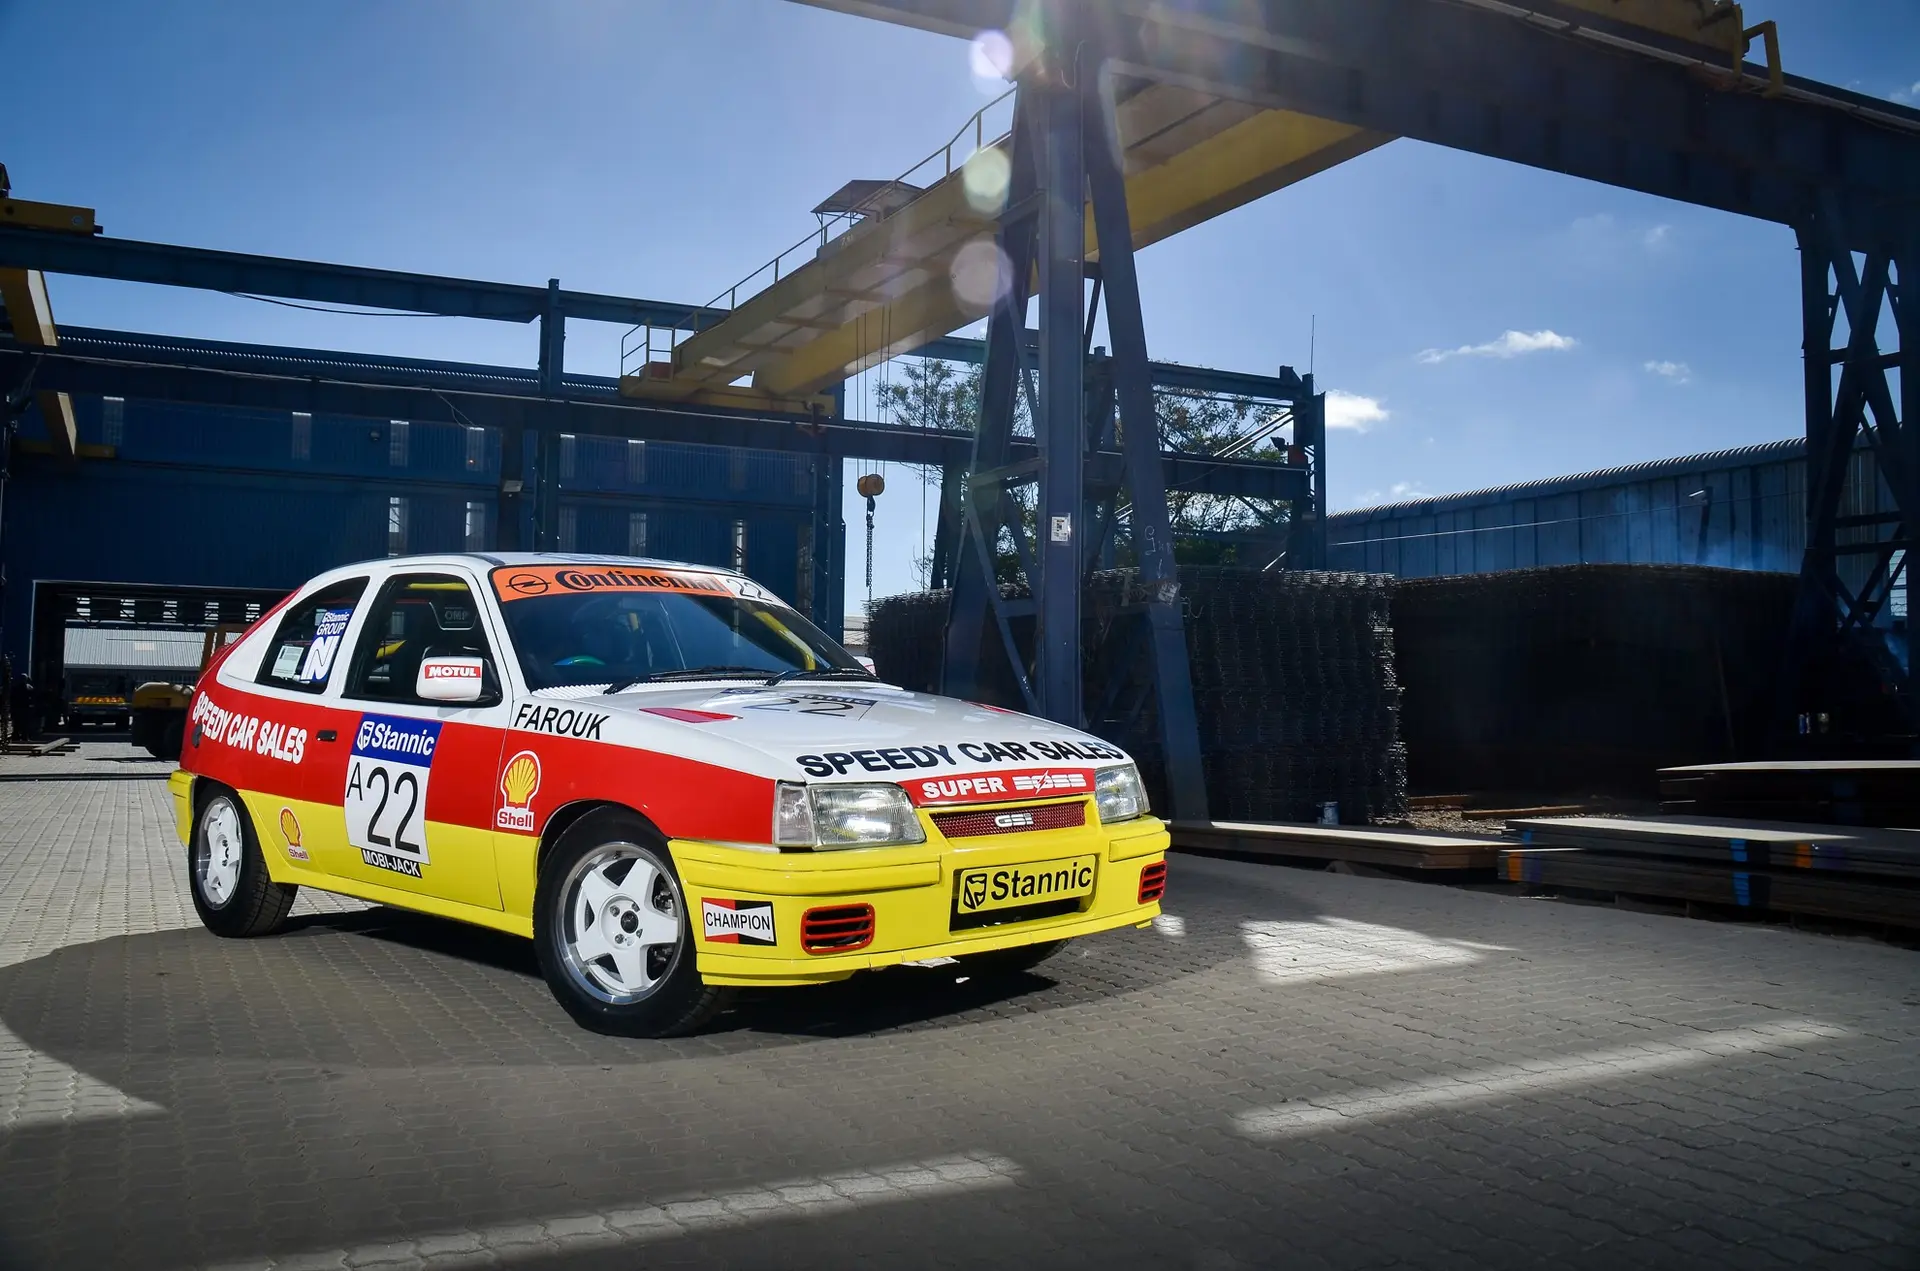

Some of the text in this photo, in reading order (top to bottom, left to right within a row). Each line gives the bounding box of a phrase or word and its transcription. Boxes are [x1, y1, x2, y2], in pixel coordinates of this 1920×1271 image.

[555, 570, 727, 592] Continental
[726, 579, 772, 601] 22
[316, 622, 346, 635] GROUP
[428, 666, 476, 677] MOTUL
[192, 691, 308, 764] SPEEDY CAR SALES
[514, 703, 611, 740] FAROUK
[371, 722, 435, 756] Stannic
[796, 740, 1125, 777] SPEEDY CAR SALES
[922, 776, 1007, 799] SUPER
[498, 811, 532, 828] Shell
[289, 848, 309, 860] Shell
[363, 849, 421, 877] MOBI-JACK
[991, 861, 1092, 901] Stannic
[706, 911, 770, 930] CHAMPION
